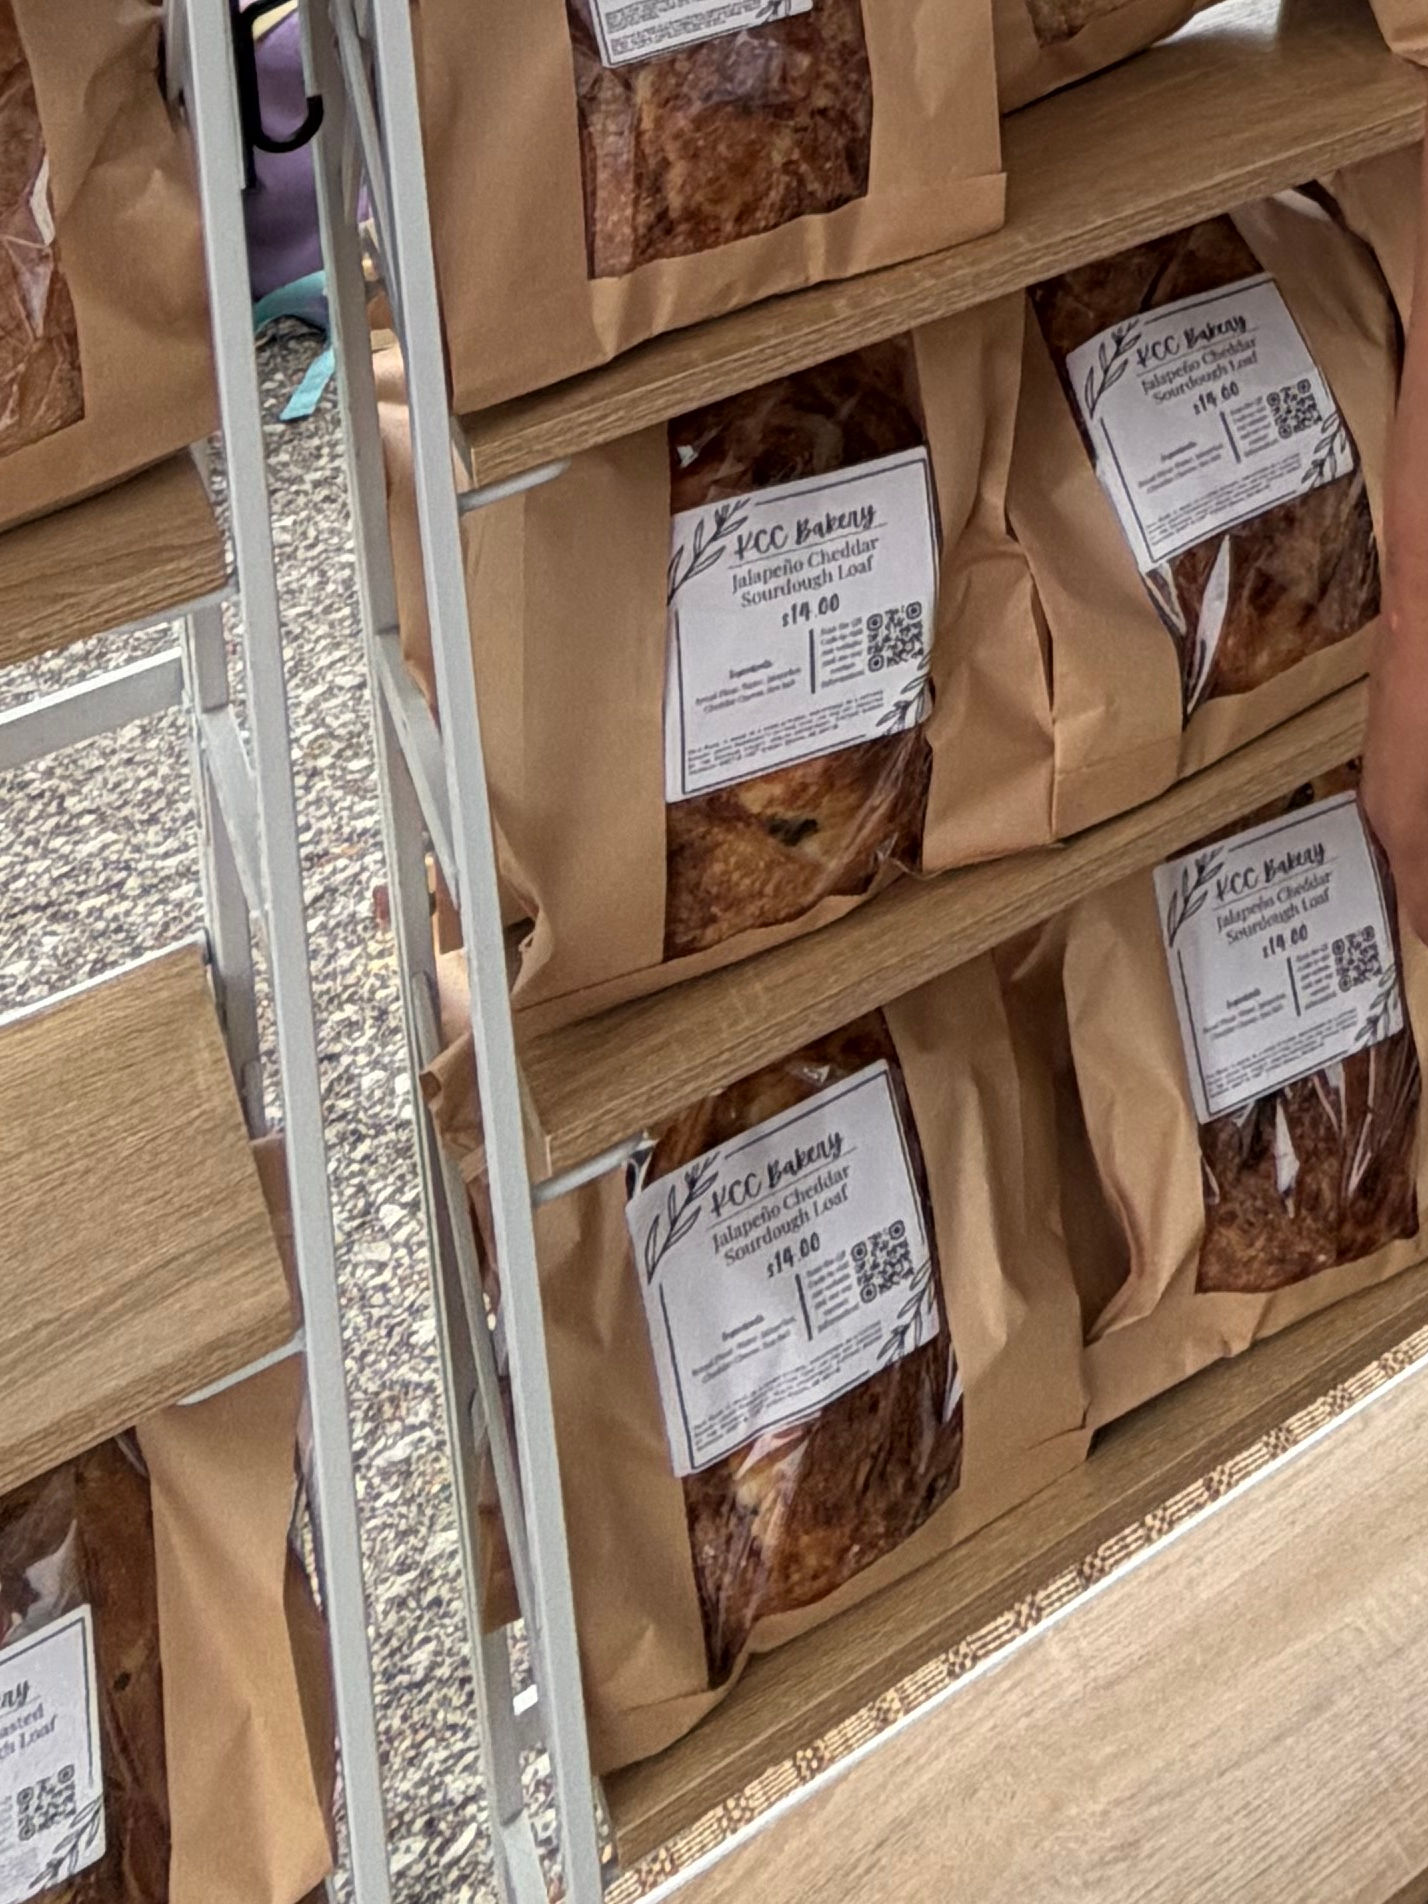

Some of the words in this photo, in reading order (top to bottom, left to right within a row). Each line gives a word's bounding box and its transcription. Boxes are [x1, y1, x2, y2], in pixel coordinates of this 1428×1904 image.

[732, 558, 804, 594] Jalapeño
[806, 537, 879, 567] Cheddar
[733, 524, 788, 560] KCC
[795, 504, 875, 545] Bakery
[741, 567, 833, 607] Sourdough
[837, 553, 873, 580] Loaf
[711, 1172, 763, 1216] KCC
[766, 1132, 842, 1188] Bakery
[712, 1204, 787, 1254] Jalapeño
[782, 1165, 849, 1210] Cheddar
[716, 1207, 810, 1265] Sourdough
[808, 1182, 848, 1217] Loaf
